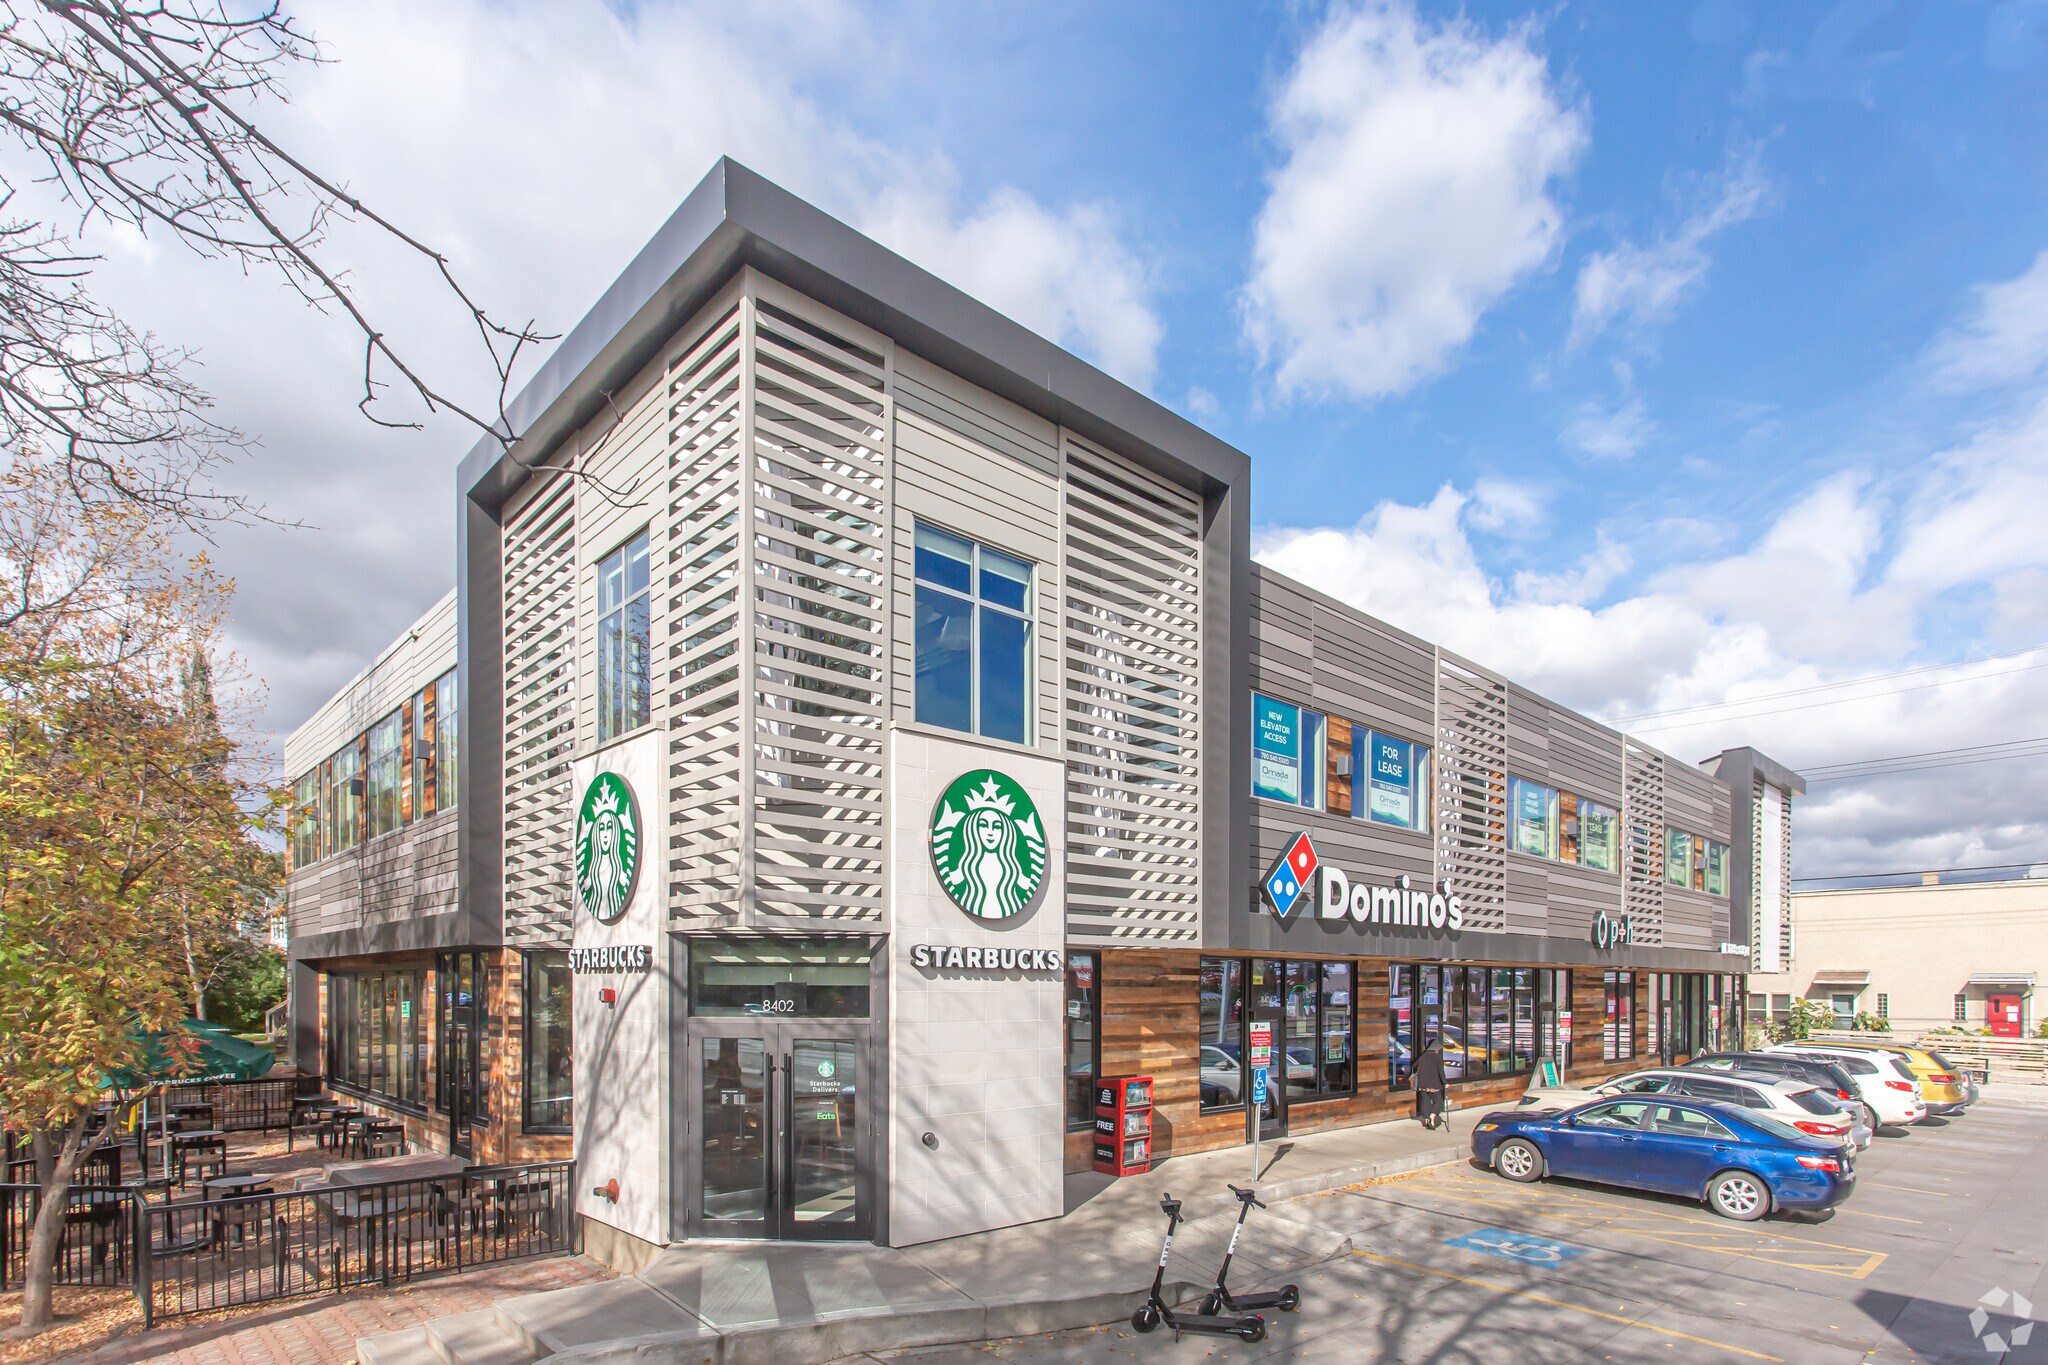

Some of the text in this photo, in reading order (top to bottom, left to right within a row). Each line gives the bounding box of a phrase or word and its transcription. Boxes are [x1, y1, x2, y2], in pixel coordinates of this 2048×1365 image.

[1268, 710, 1283, 722] NEW
[1260, 719, 1291, 735] ELEVATOR
[1264, 731, 1287, 744] ACCESS
[1382, 745, 1399, 760] FOR
[1262, 765, 1289, 779] Omada
[1378, 760, 1403, 777] LEASE
[1590, 822, 1603, 834] LEASE
[1321, 866, 1463, 930] Domino's
[568, 945, 645, 969] STARBUCKS
[914, 944, 1061, 970] STARBUCKS
[762, 1000, 795, 1012] 8402
[817, 1112, 836, 1120] Eats
[1096, 1120, 1114, 1132] FREE
